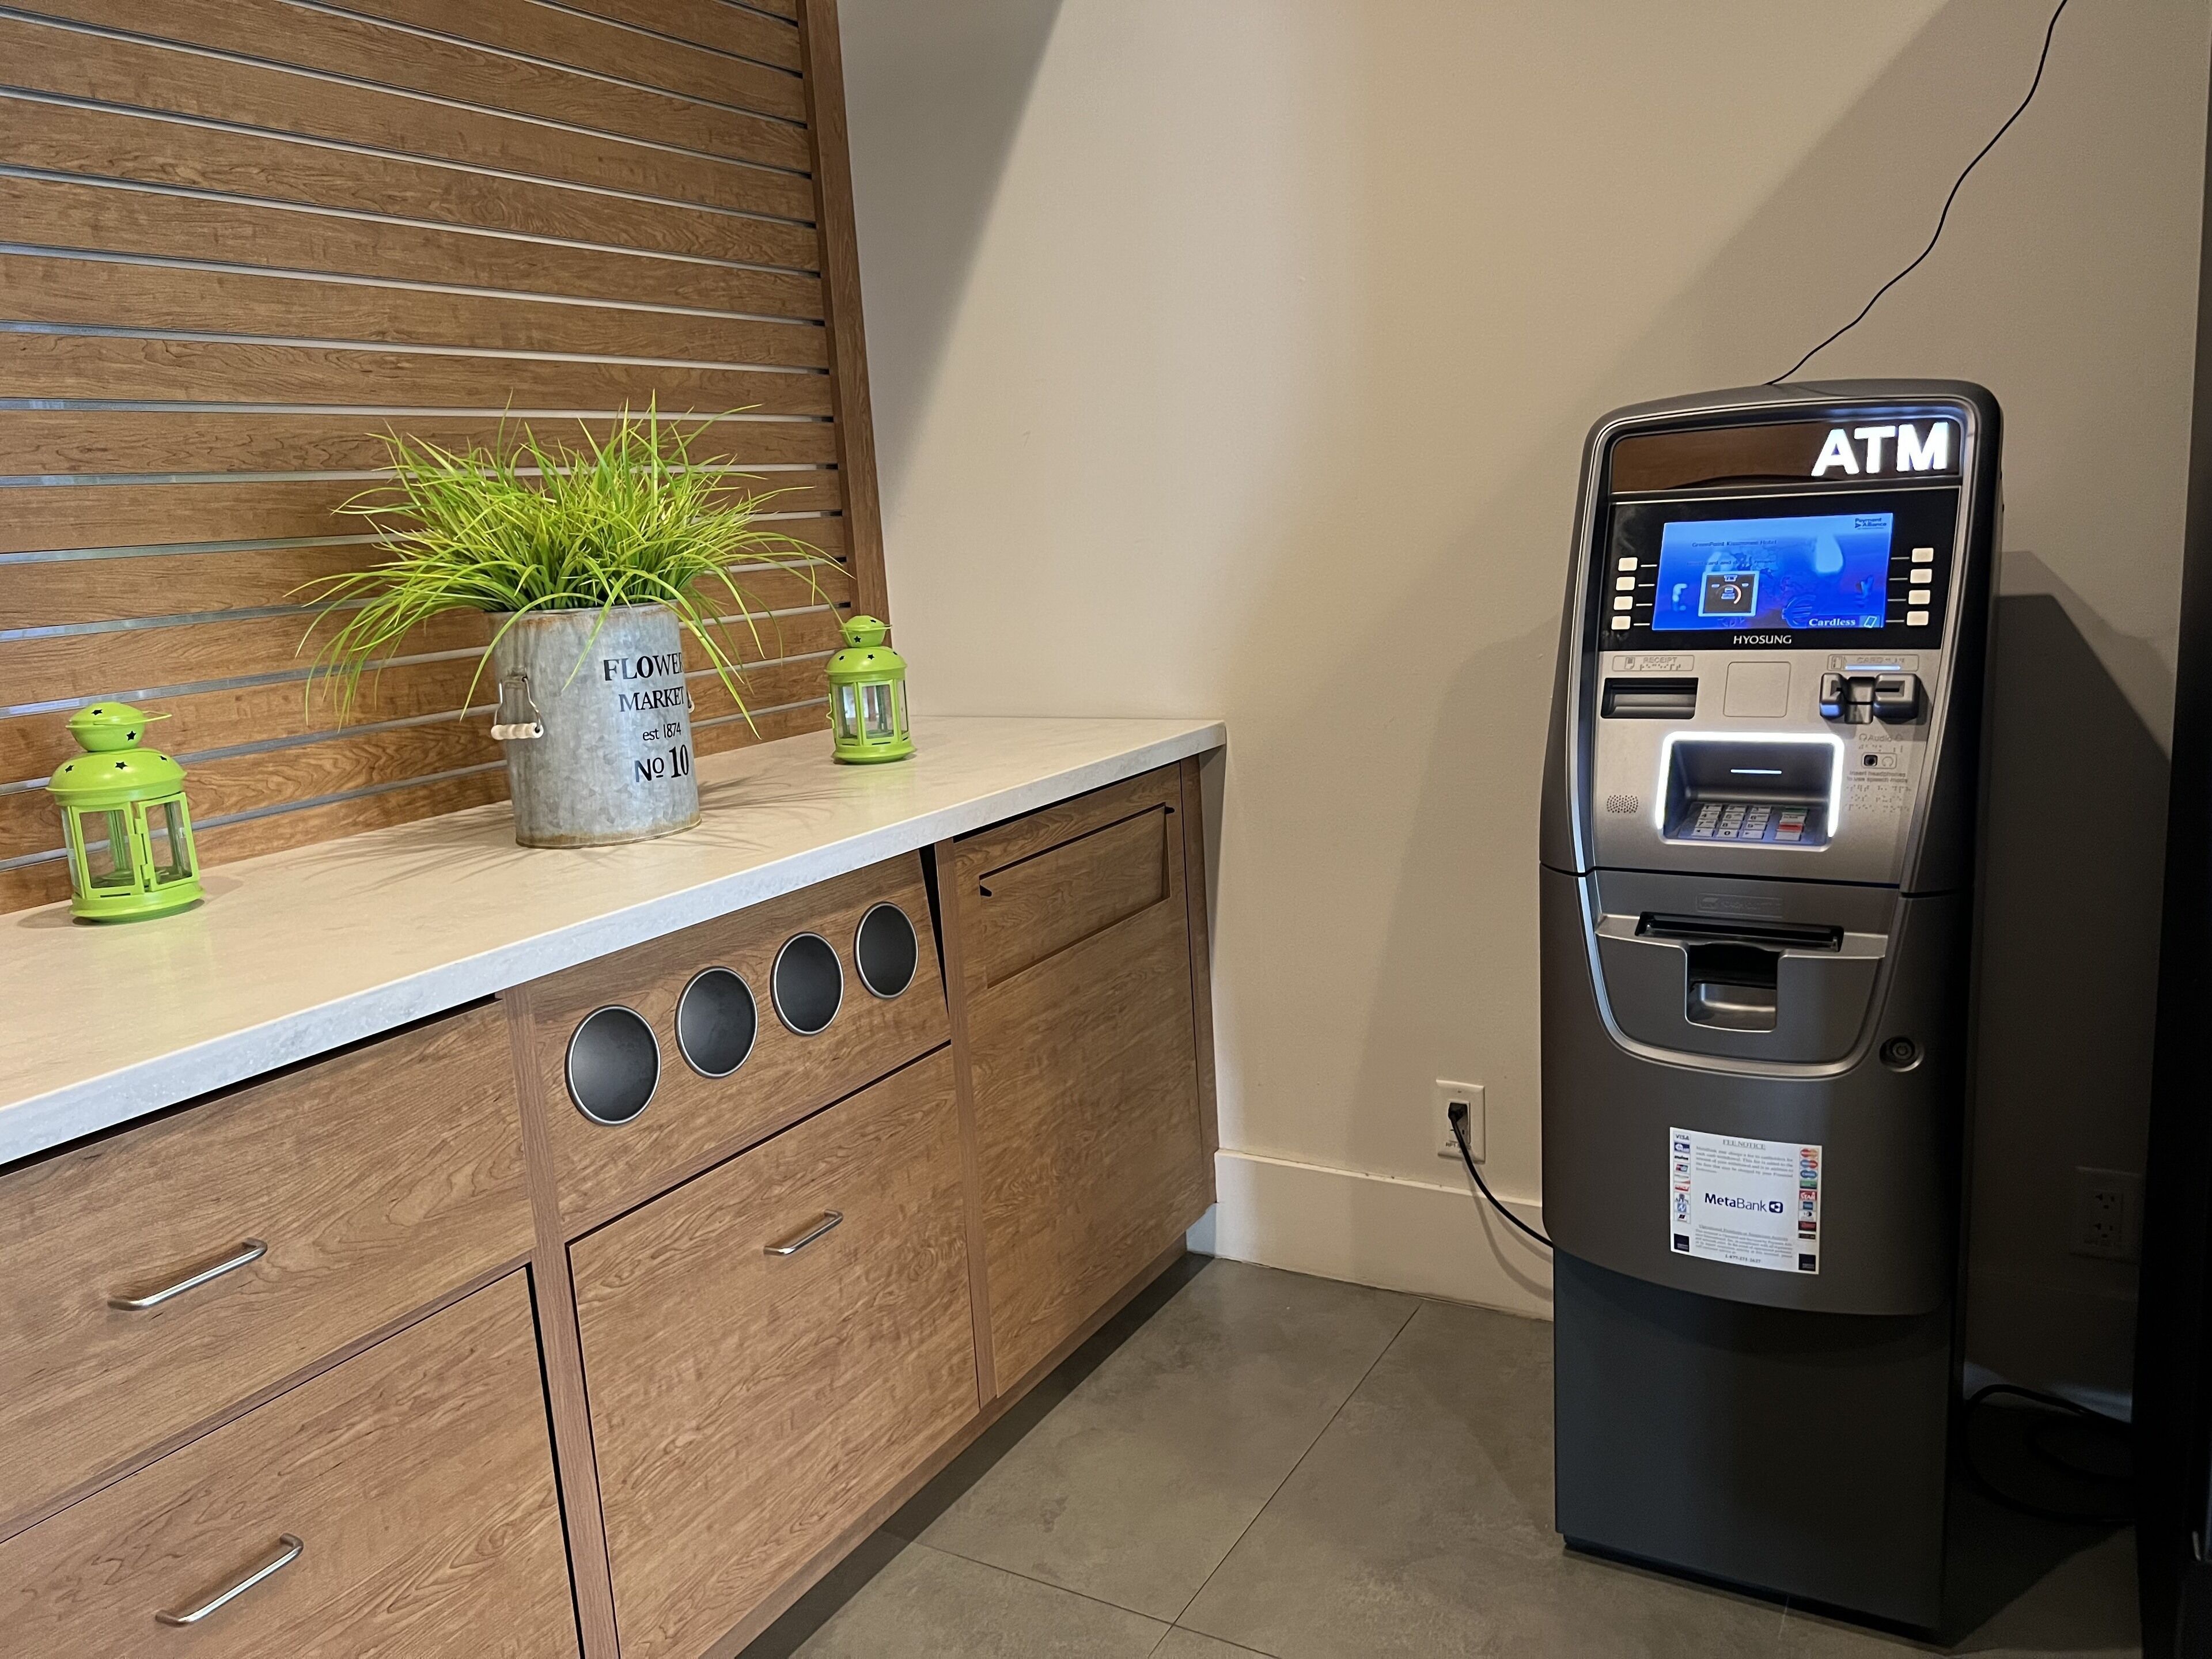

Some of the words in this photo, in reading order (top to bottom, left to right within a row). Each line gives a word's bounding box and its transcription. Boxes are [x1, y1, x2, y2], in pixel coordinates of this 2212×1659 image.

[1810, 422, 1949, 477] ATM
[1808, 618, 1856, 626] Cardless
[1733, 635, 1792, 644] HYOSUNG
[618, 686, 684, 712] MARKET
[642, 728, 660, 741] est
[663, 722, 681, 738] 1874
[669, 744, 689, 778] 10
[1738, 1141, 1766, 1150] NOTICE
[1704, 1193, 1767, 1213] MetaBank
